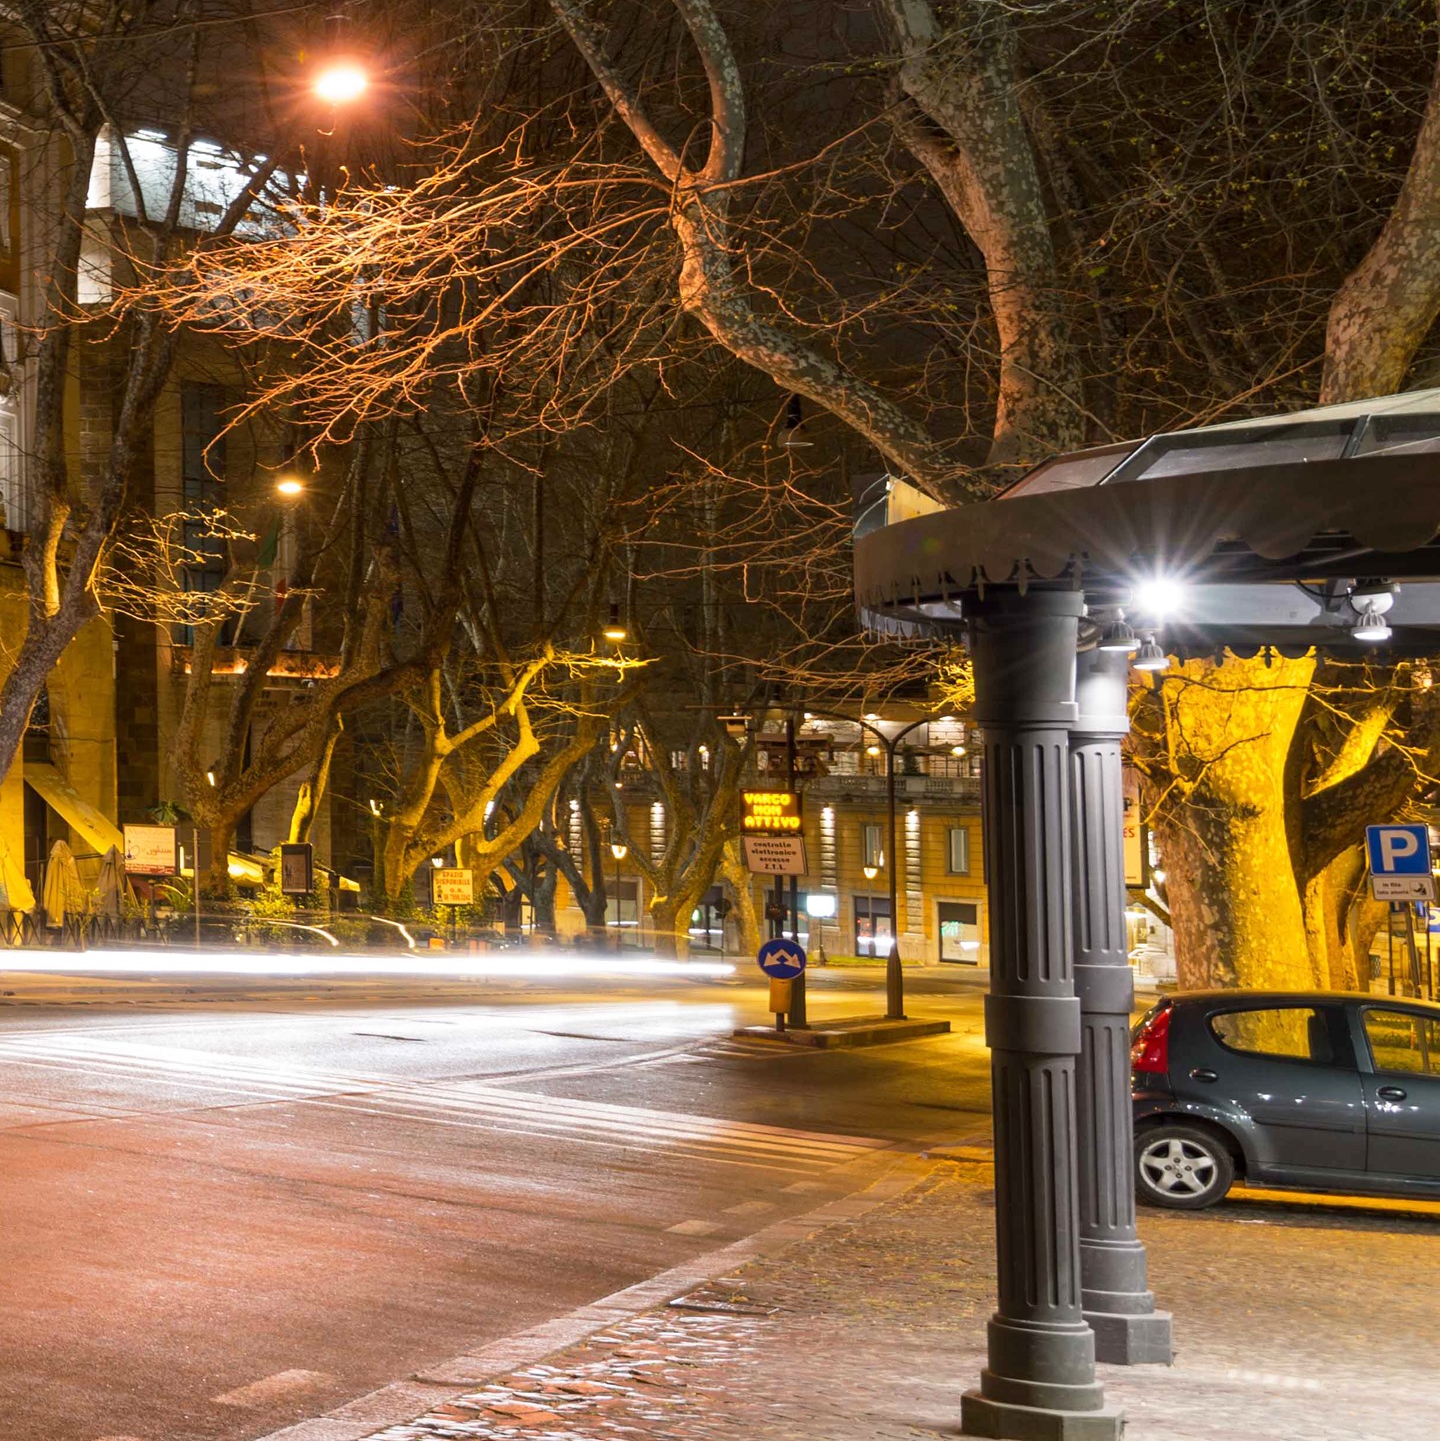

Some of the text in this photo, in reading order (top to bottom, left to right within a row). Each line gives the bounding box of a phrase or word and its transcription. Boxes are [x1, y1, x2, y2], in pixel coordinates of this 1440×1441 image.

[743, 792, 791, 806] VARCO
[752, 804, 783, 816] NON
[744, 815, 801, 829] ATTIVO
[751, 848, 797, 856] elettronico
[1379, 829, 1419, 872] P
